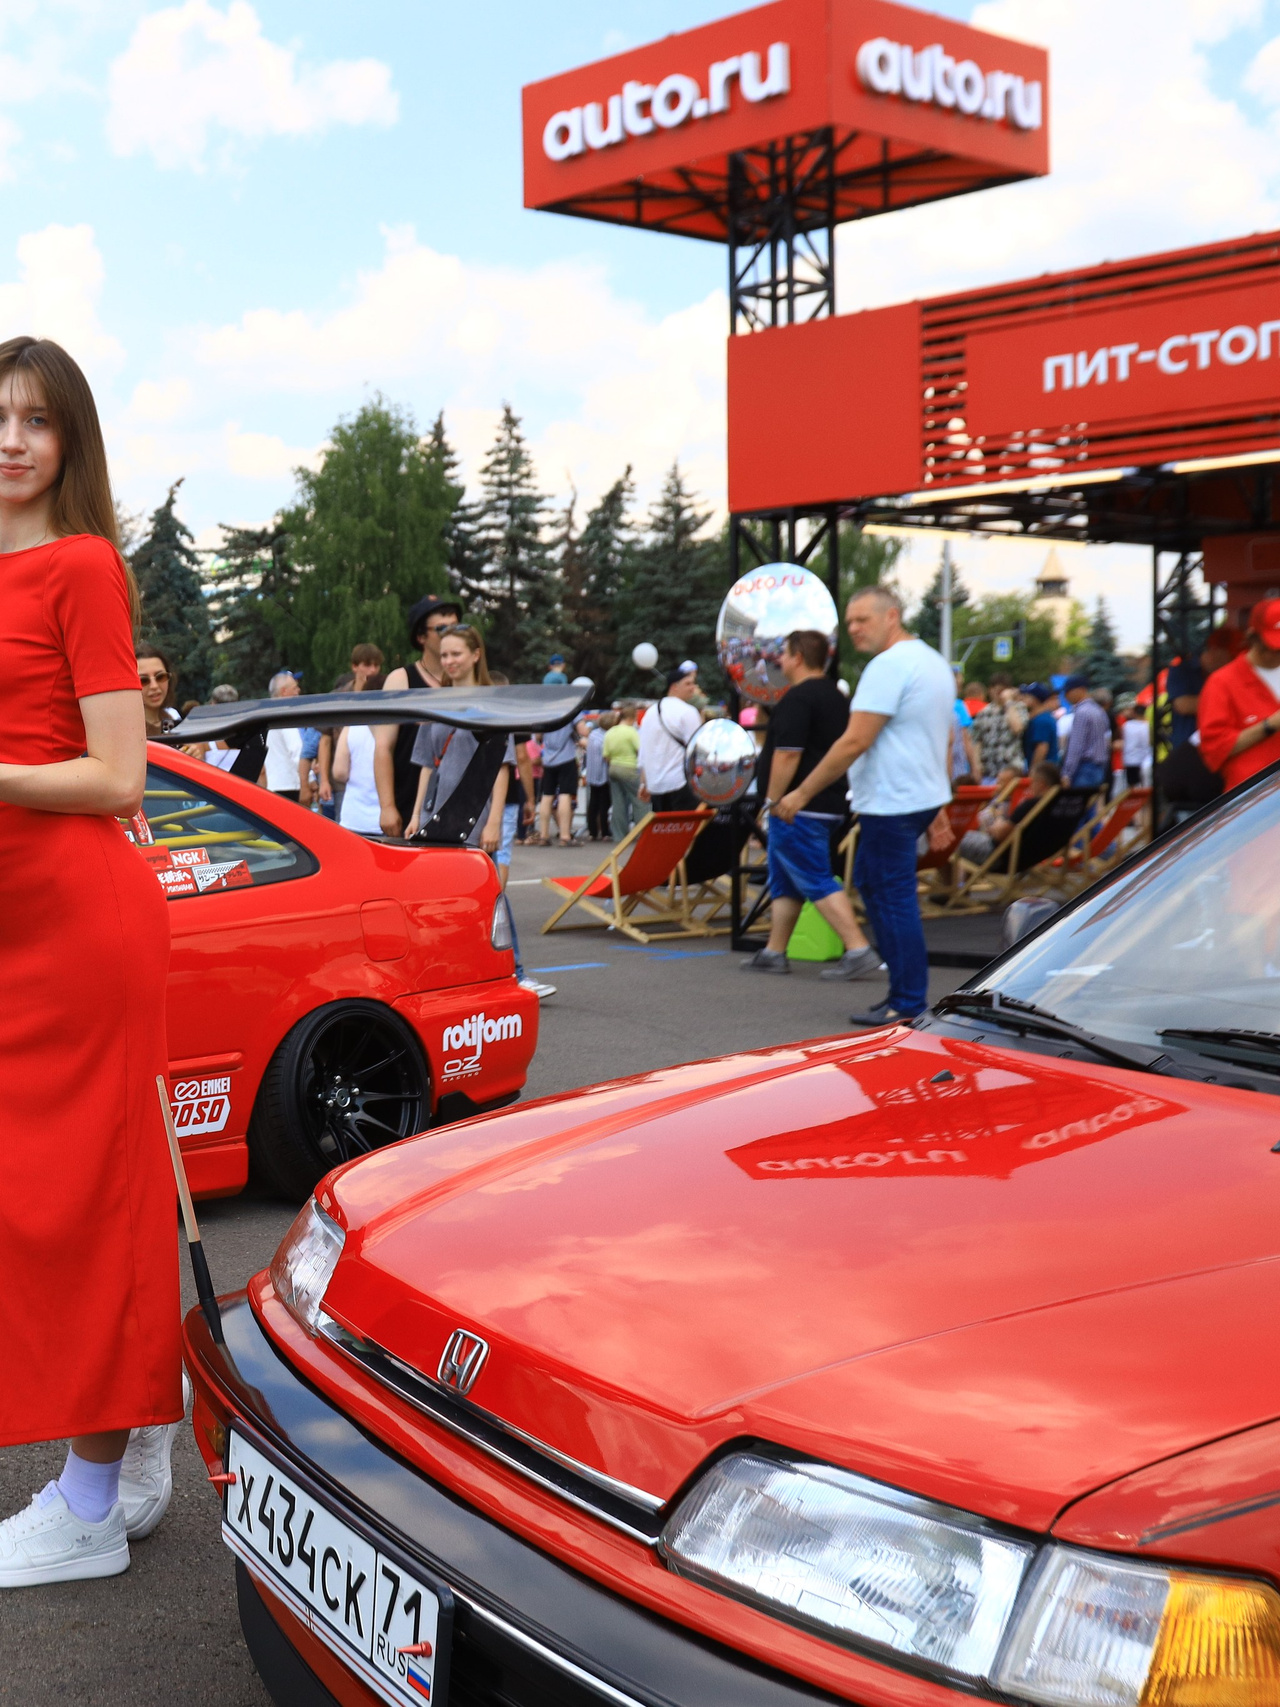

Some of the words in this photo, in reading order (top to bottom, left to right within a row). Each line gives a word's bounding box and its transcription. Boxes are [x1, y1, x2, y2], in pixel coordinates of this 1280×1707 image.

[543, 42, 789, 161] auto.ru
[857, 38, 1042, 130] auto.ru
[734, 574, 805, 596] auto.ru
[171, 851, 201, 866] NGK
[442, 1012, 522, 1056] rotiform
[201, 1077, 231, 1096] ENKEI
[442, 1072, 479, 1082] RACING
[382, 1564, 422, 1660] 71
[376, 1633, 407, 1677] RUS
